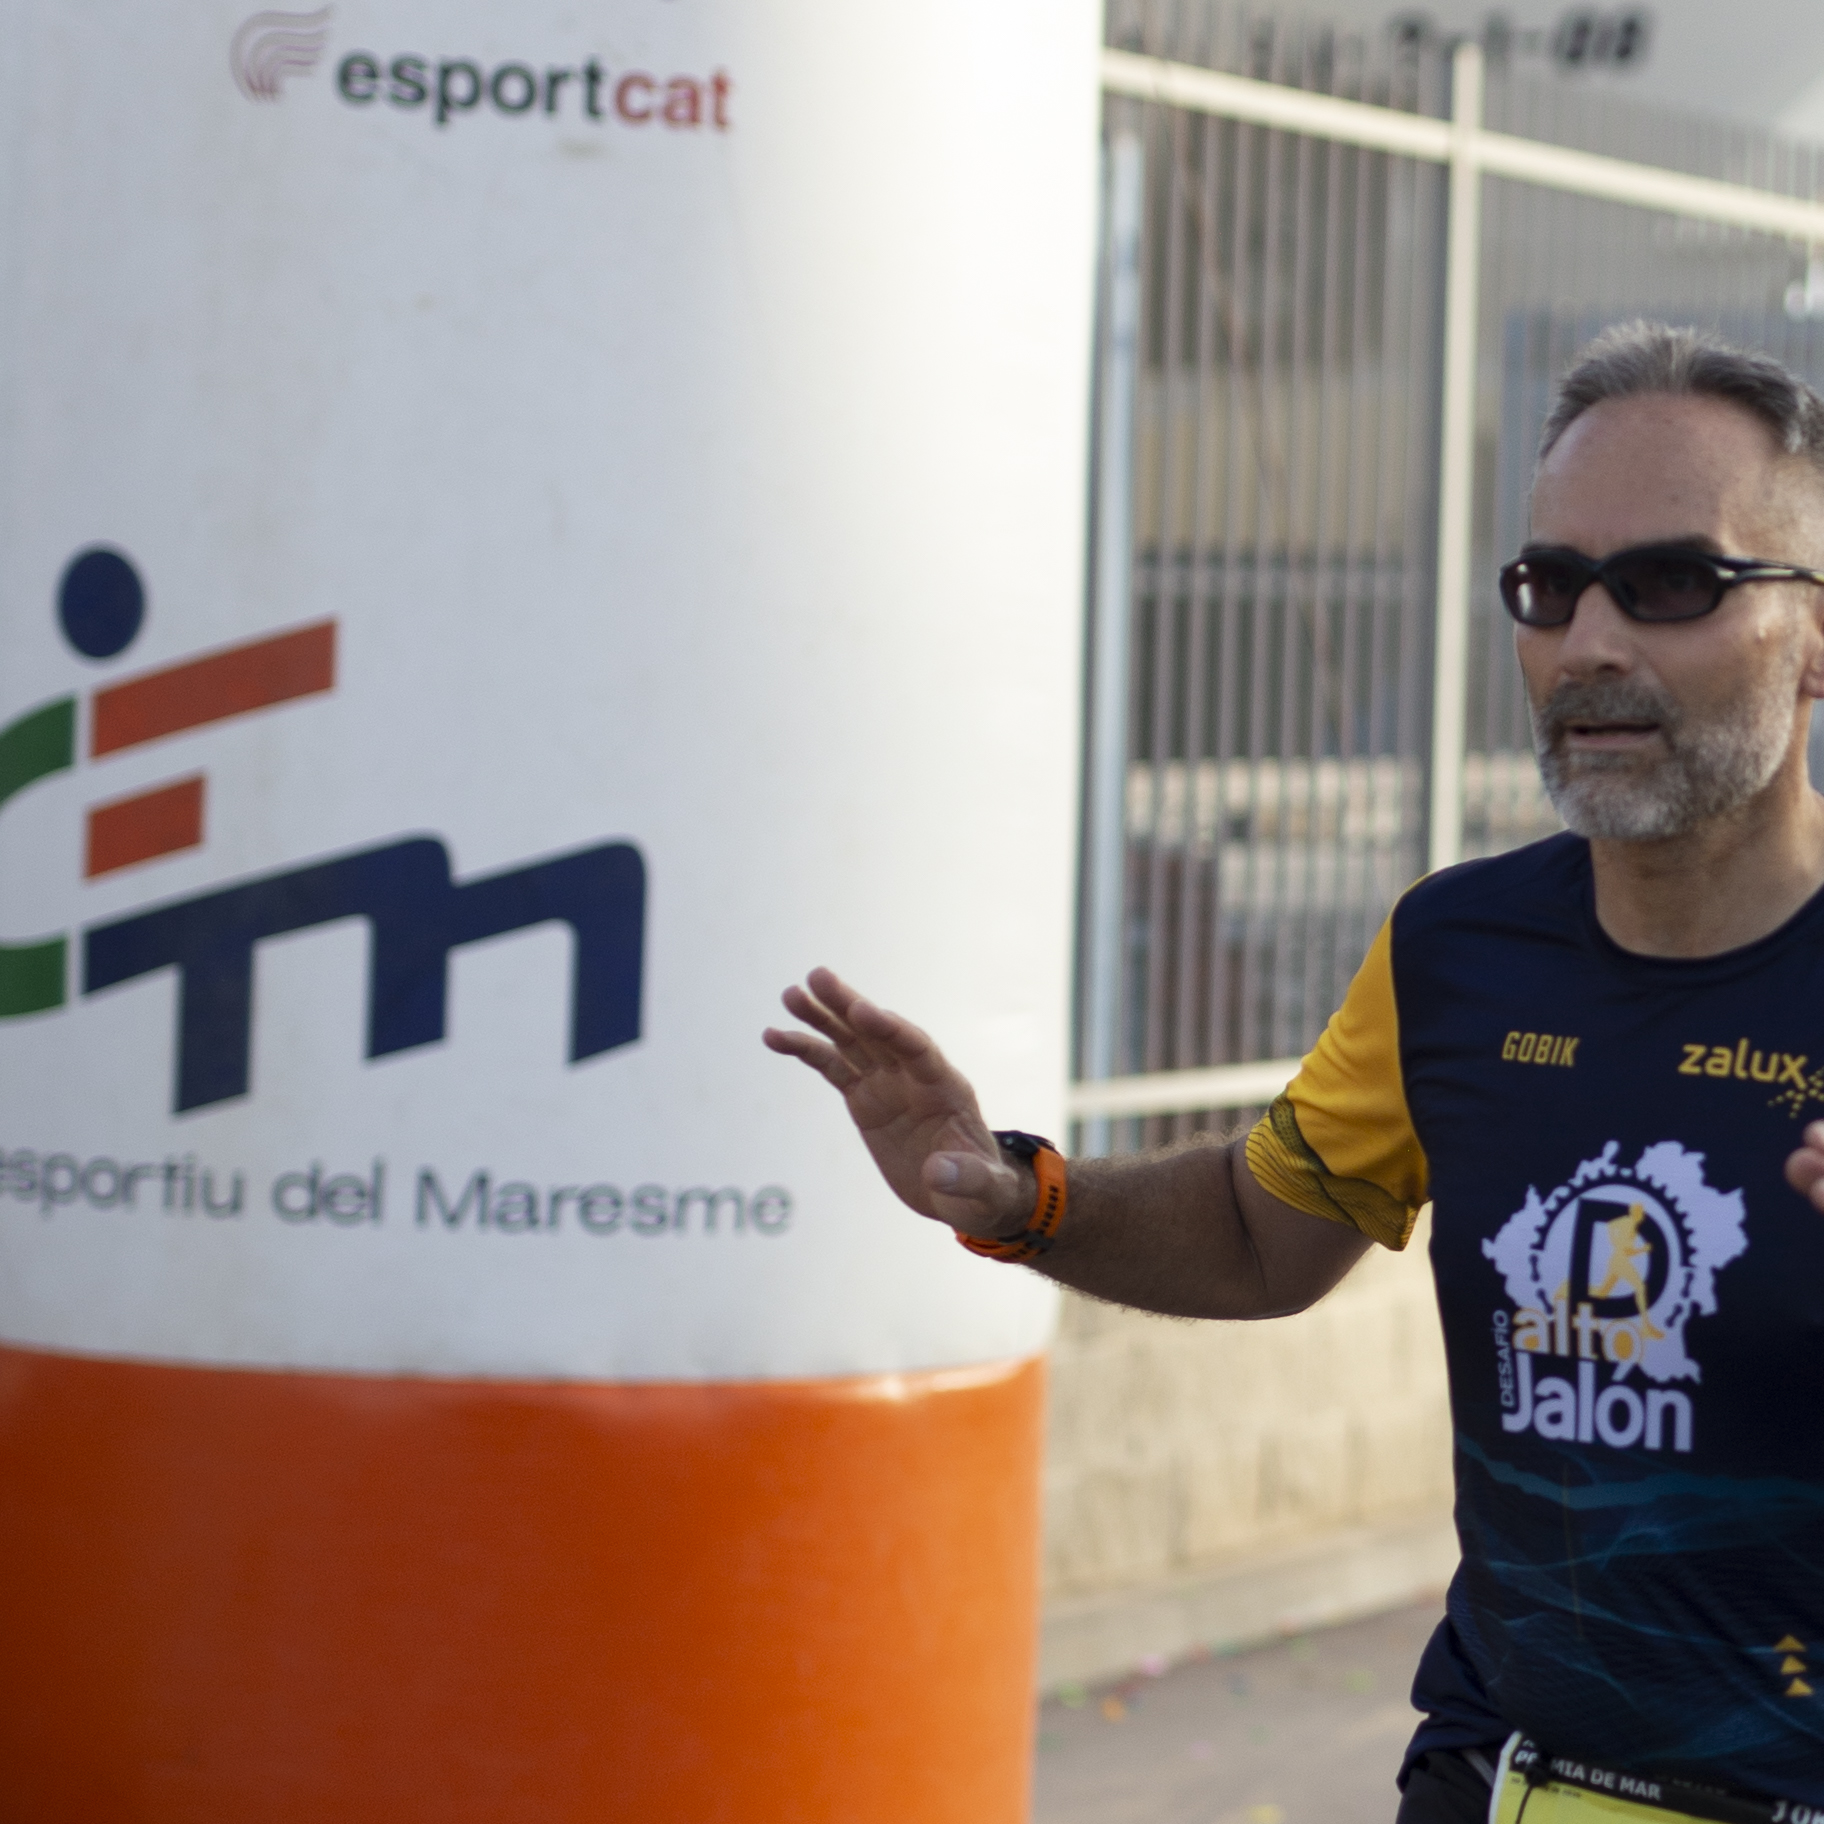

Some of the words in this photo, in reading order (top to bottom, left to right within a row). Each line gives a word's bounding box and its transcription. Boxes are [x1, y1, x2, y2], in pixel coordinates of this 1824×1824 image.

[336, 50, 733, 133] esportcat
[1501, 1030, 1580, 1068] GOBIK
[1677, 1036, 1808, 1088] zalux
[0, 1147, 246, 1219] sportiu
[269, 1156, 385, 1226] del
[413, 1165, 795, 1238] Maresme
[1511, 1294, 1644, 1363] alto
[1501, 1351, 1693, 1453] Jalón
[1590, 1767, 1616, 1790] DE
[1618, 1775, 1663, 1802] MAR
